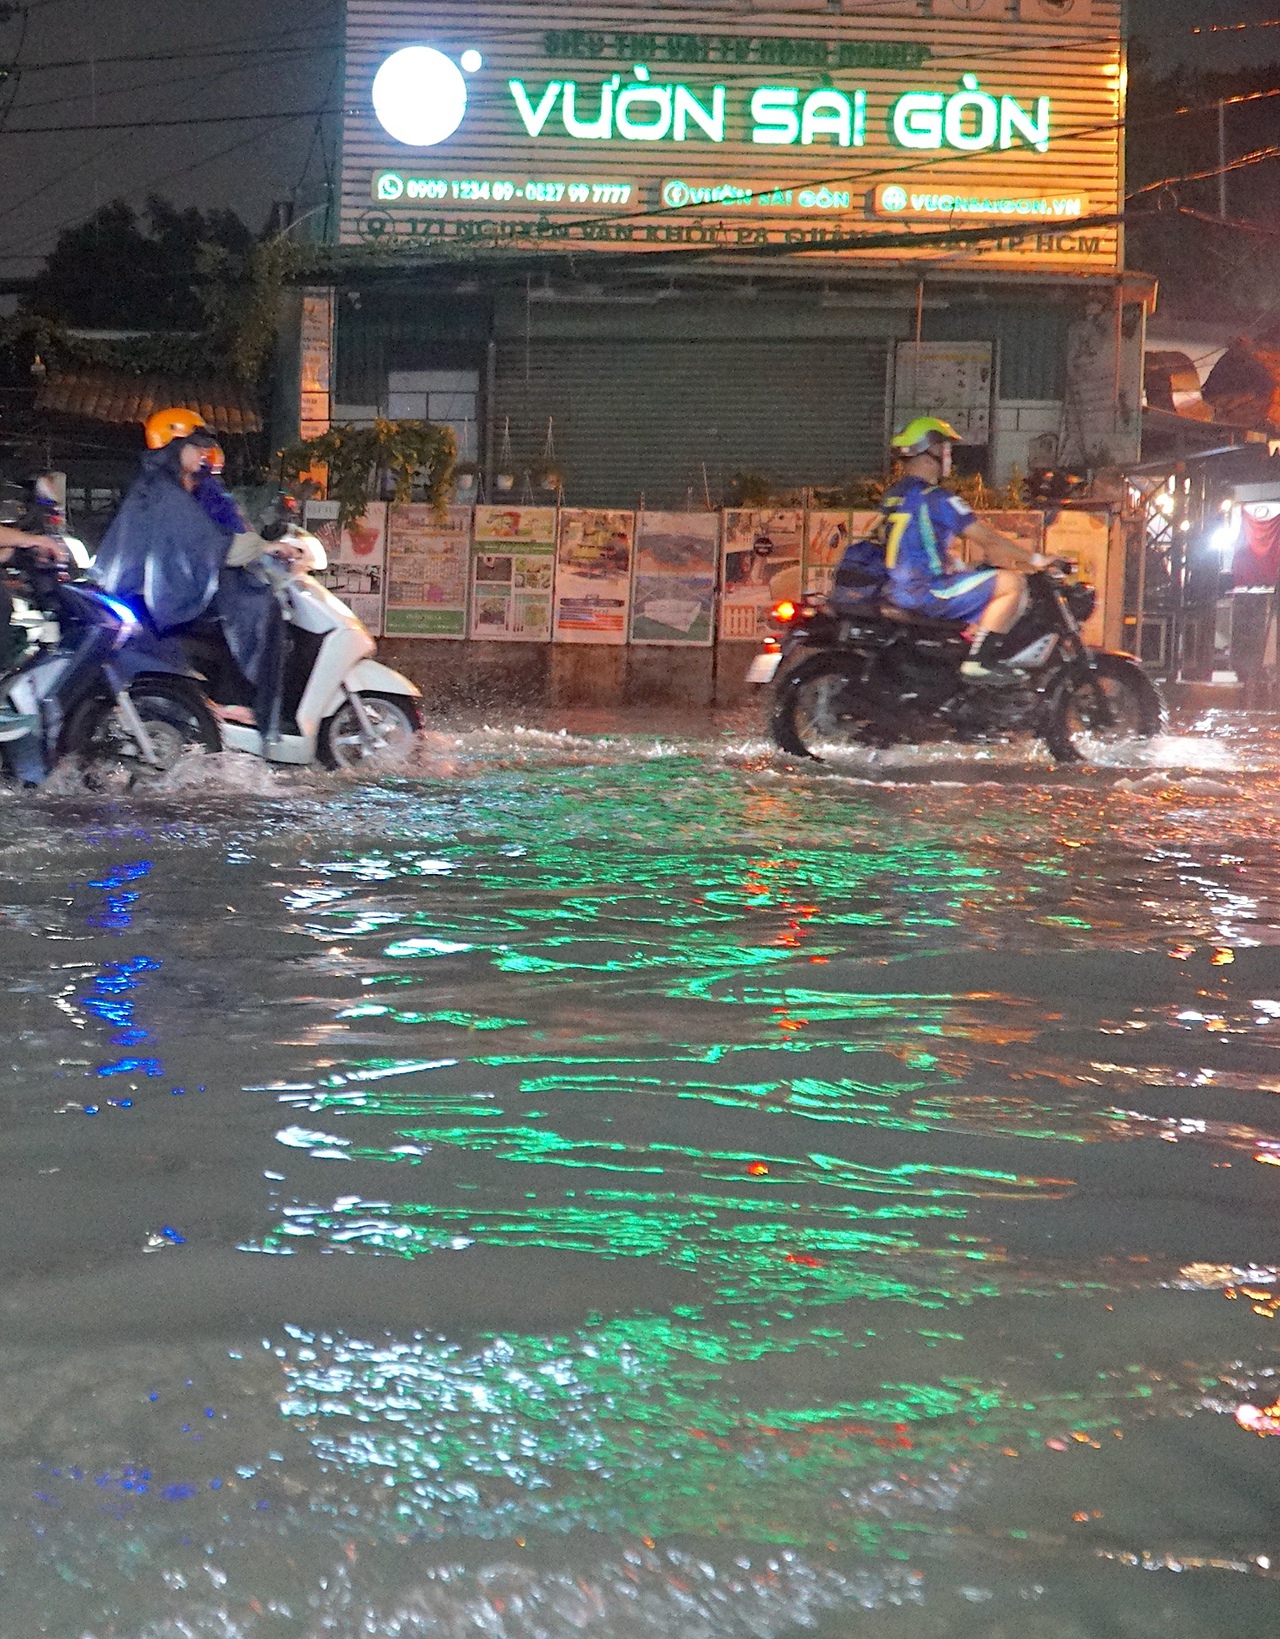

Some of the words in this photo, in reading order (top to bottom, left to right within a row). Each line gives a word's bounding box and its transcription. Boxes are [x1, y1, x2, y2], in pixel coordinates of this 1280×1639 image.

[508, 63, 726, 142] VƯỜN
[892, 73, 1050, 153] GÒN
[407, 179, 448, 198] 0909
[451, 180, 491, 200] 1234
[592, 184, 632, 205] 7777
[797, 187, 850, 209] GÒN
[1036, 234, 1100, 255] HCM
